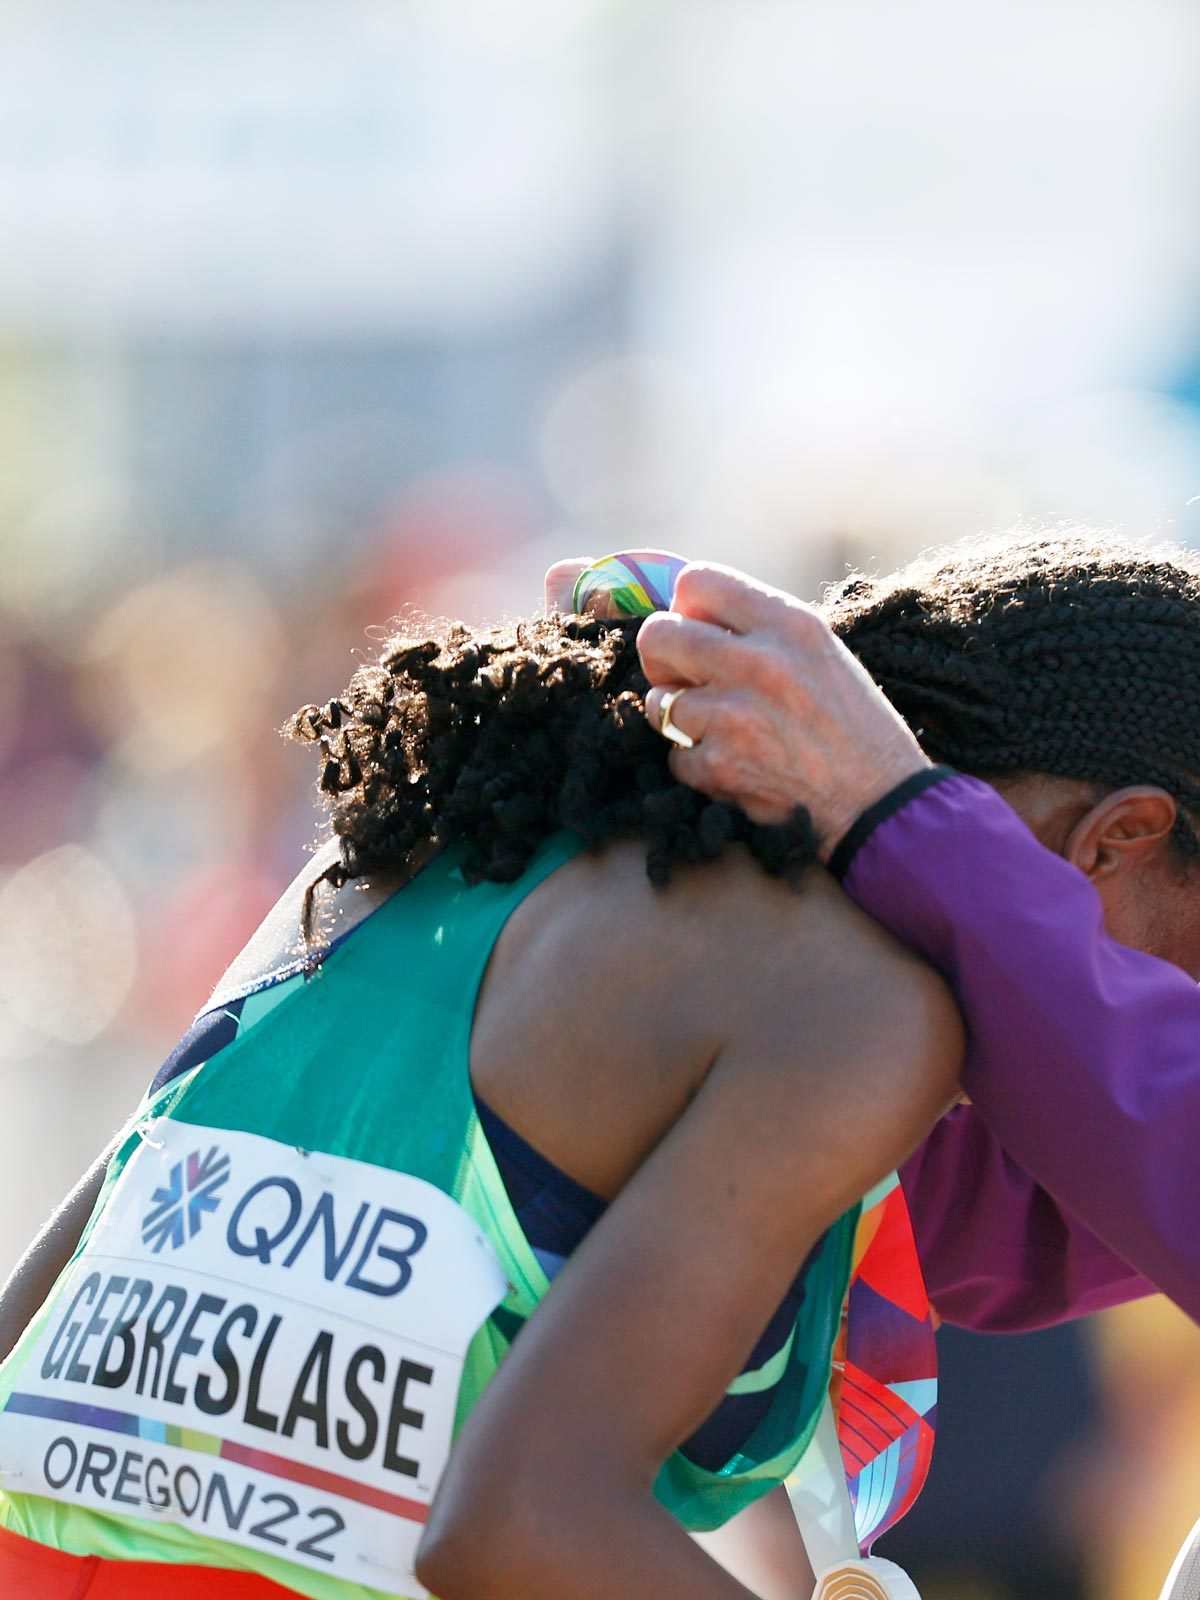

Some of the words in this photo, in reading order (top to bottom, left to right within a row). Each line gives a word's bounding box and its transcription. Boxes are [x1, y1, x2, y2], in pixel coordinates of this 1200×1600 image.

[227, 1176, 428, 1297] QNB
[41, 1272, 434, 1479] GEBRESLASE
[43, 1436, 346, 1562] OREGON22
